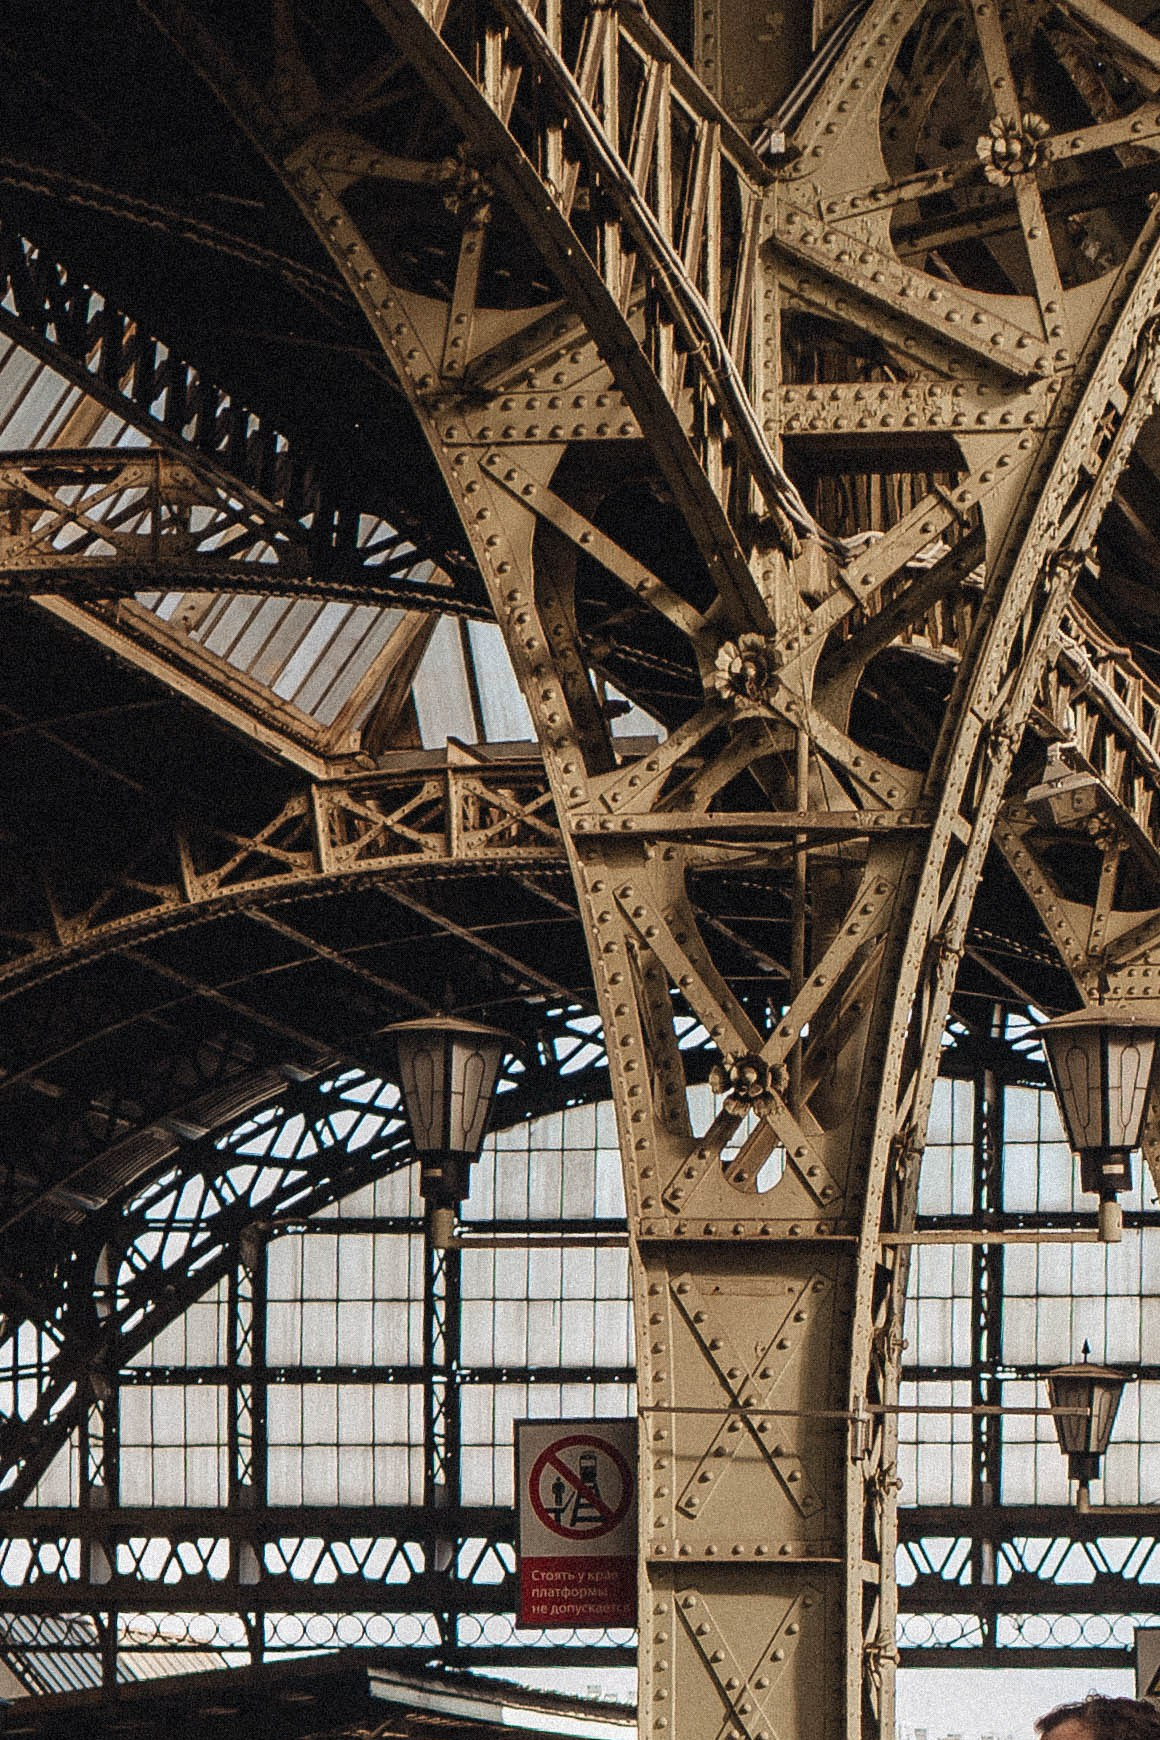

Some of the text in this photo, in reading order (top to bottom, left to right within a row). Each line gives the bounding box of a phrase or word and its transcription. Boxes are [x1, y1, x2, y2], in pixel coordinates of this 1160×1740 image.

[531, 1570, 575, 1581] Стоять
[577, 1572, 585, 1583] у
[531, 1586, 609, 1599] платформы
[531, 1604, 548, 1614] не
